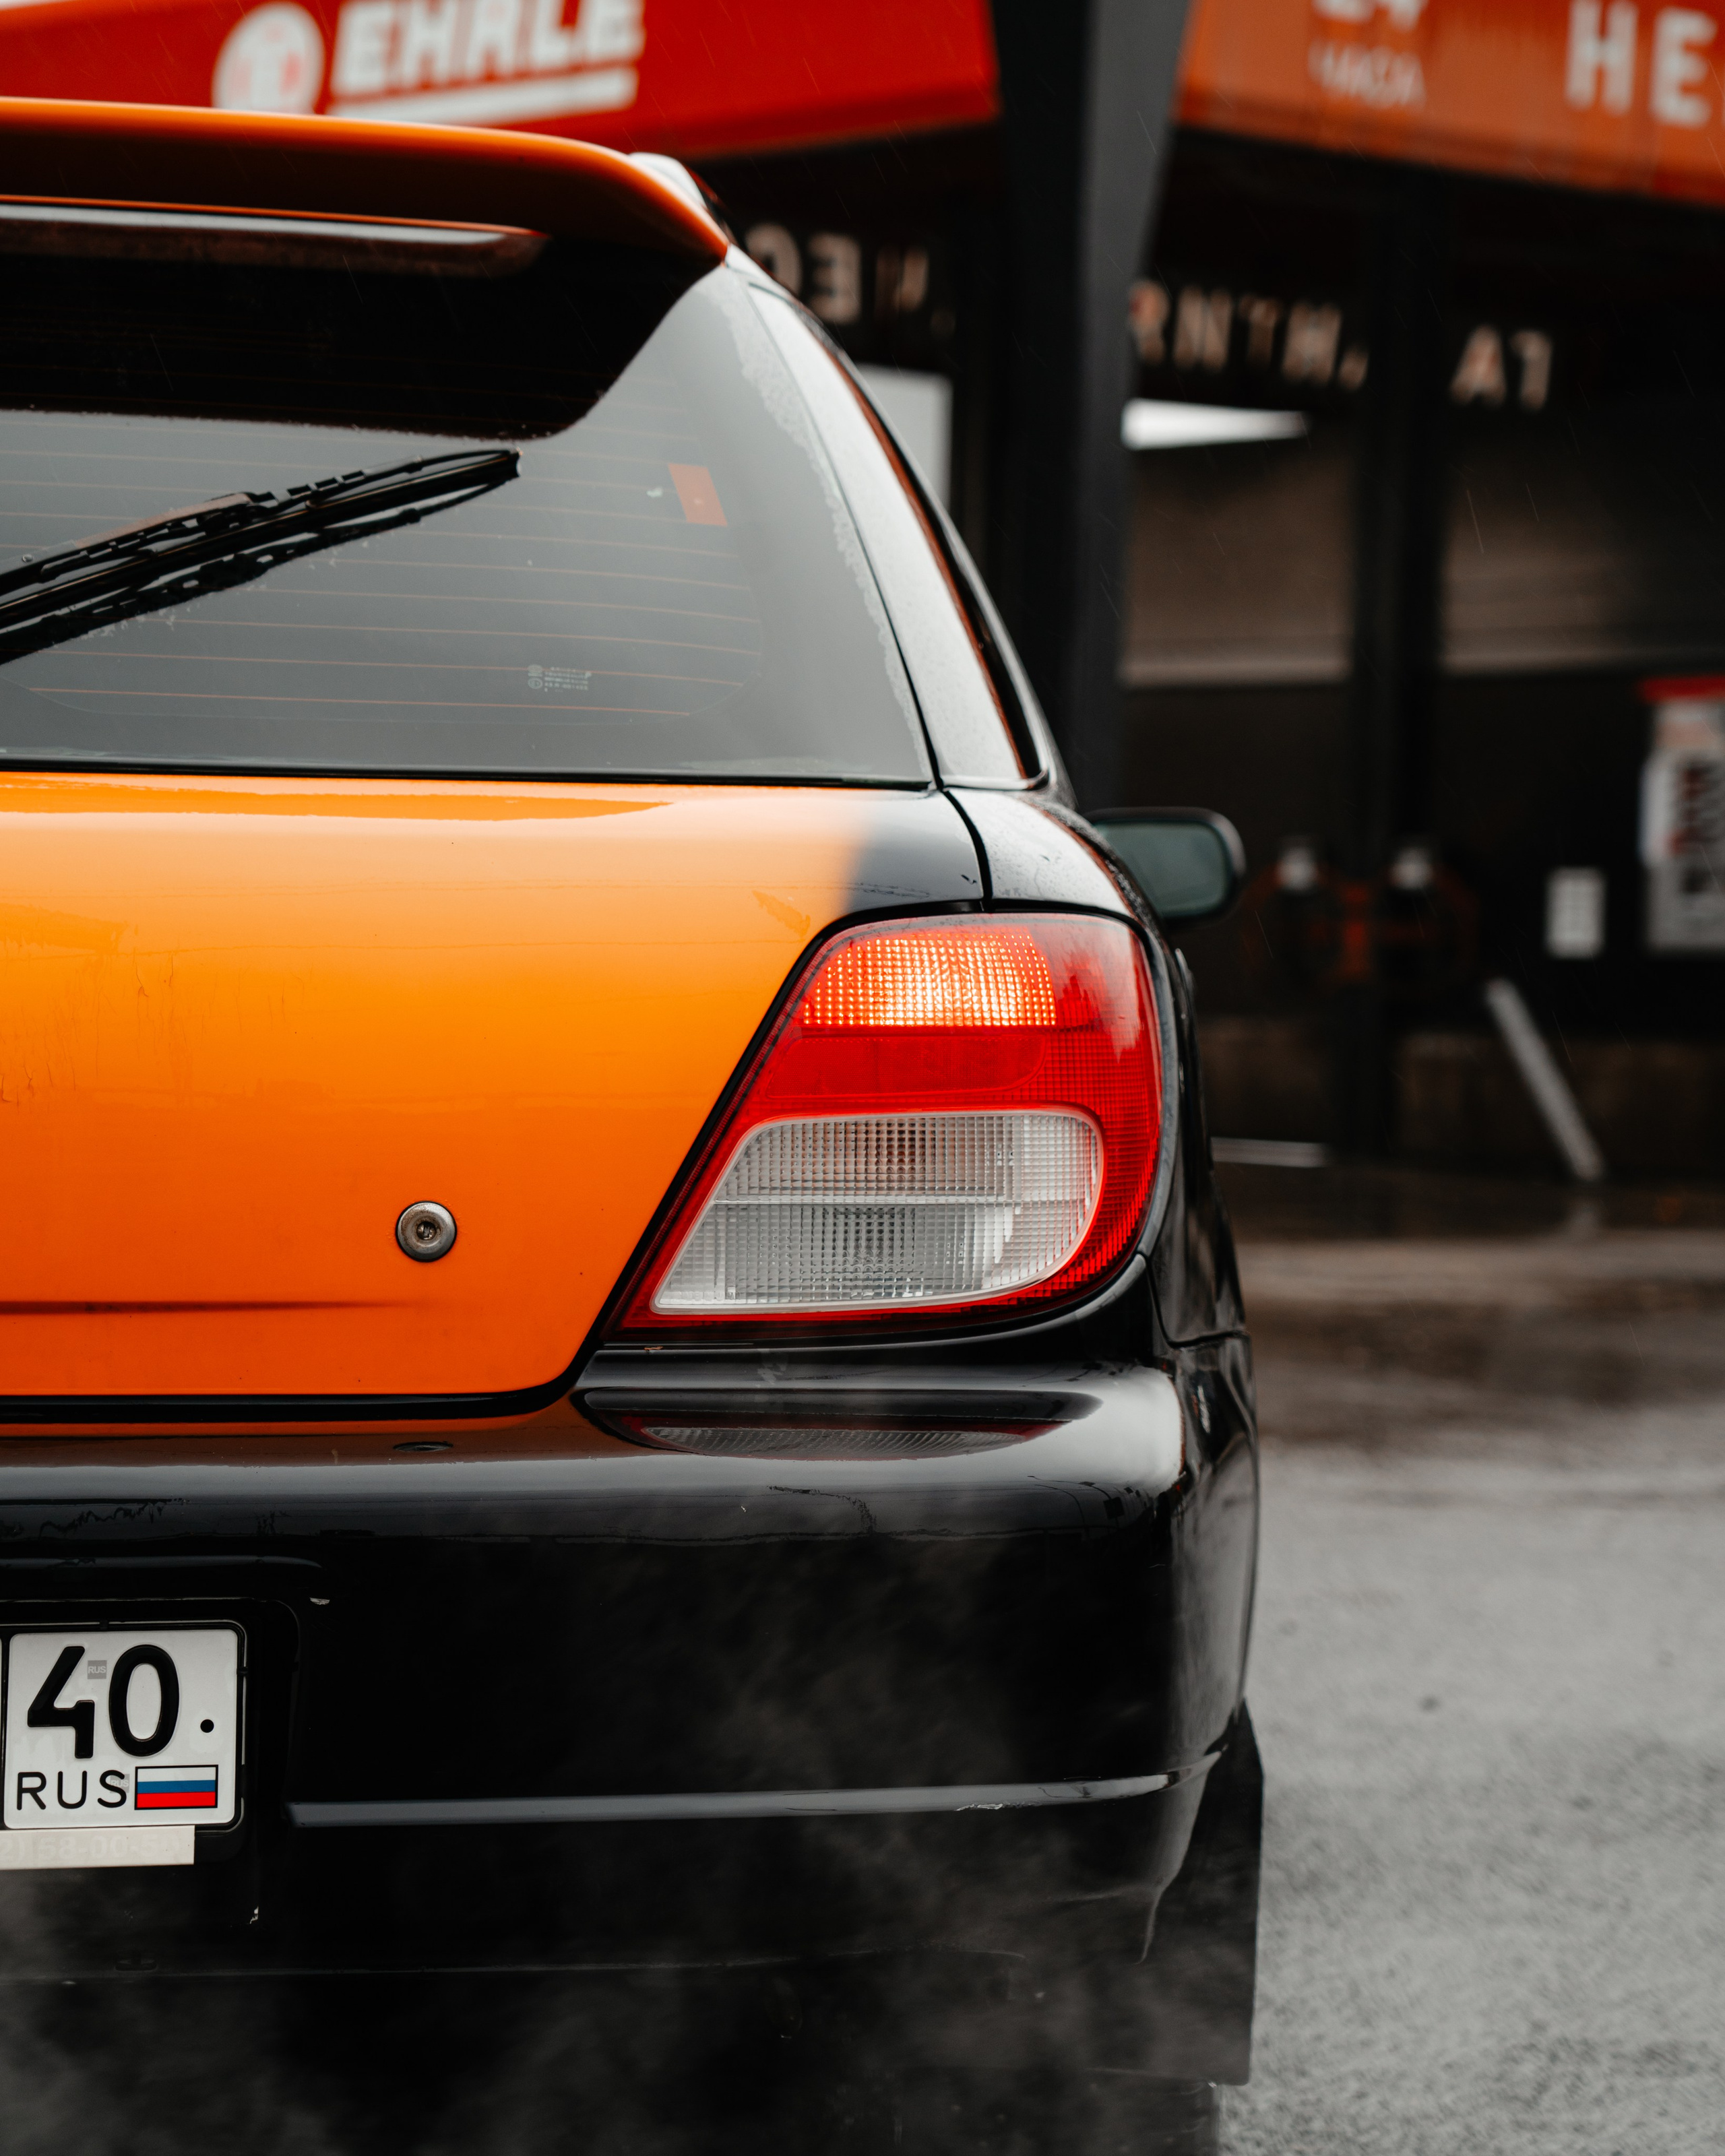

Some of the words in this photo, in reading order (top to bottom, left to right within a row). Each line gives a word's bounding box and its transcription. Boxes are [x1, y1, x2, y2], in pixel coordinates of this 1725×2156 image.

[88, 1666, 106, 1674] RUS
[27, 1644, 180, 1758] 40
[16, 1769, 127, 1810] RUS
